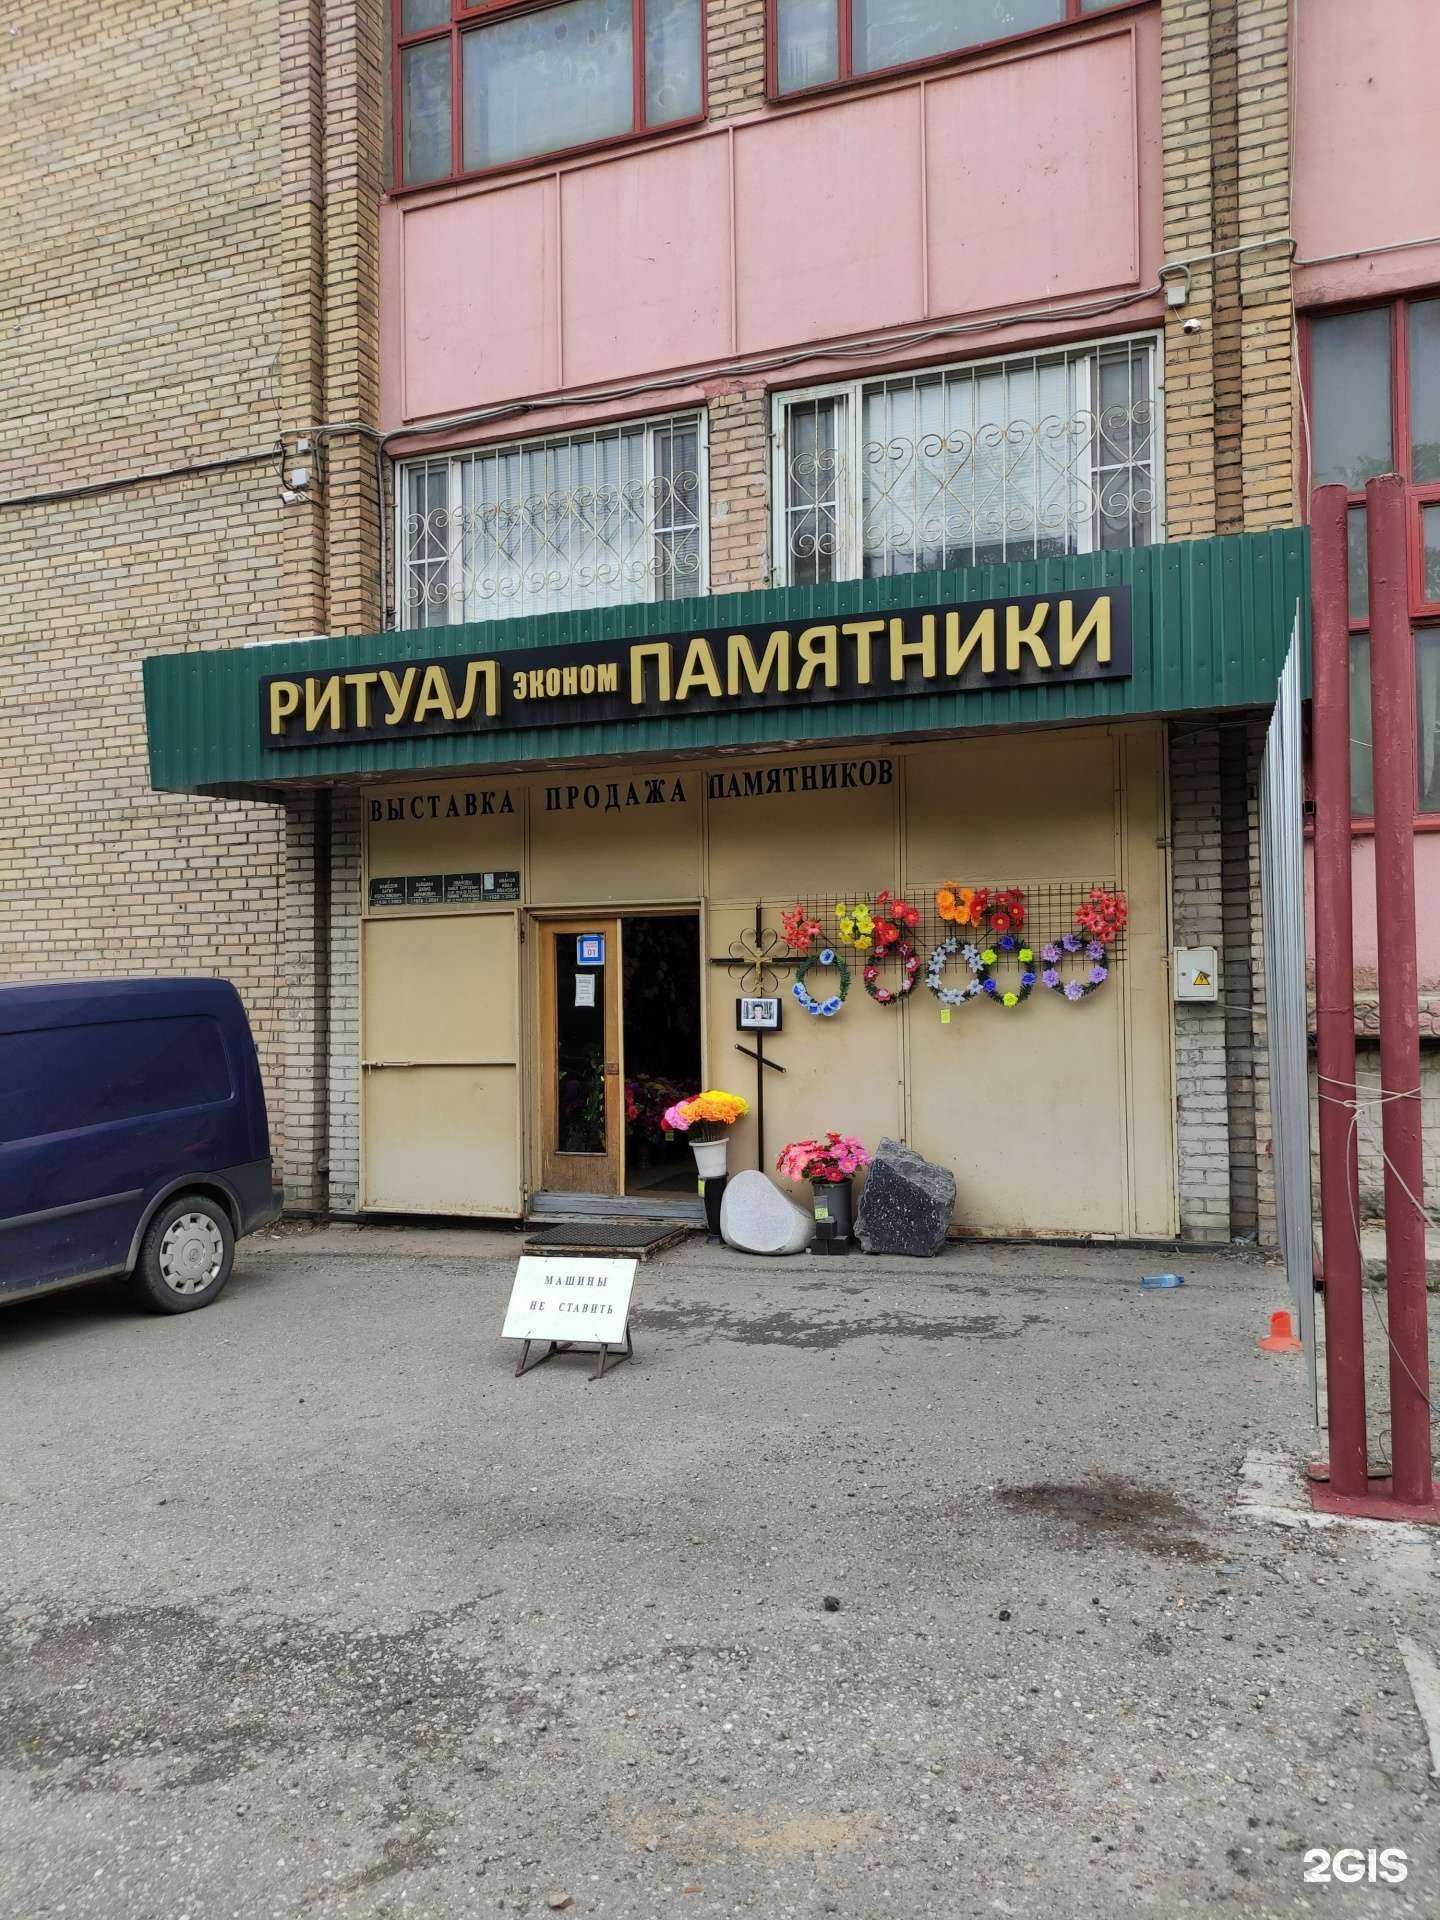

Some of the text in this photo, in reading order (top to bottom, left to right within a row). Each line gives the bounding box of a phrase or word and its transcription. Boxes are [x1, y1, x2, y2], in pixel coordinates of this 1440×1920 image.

[269, 660, 499, 735] РИТУАЛ
[630, 596, 1112, 704] ПАМЯТНИКИ
[371, 759, 893, 822] ВЫСТАВКА ПРОДАЖА ПАМЯТНИКОВ
[544, 1275, 609, 1287] МАШИНЫ
[529, 1300, 614, 1314] НЕ СТАВИТЬ
